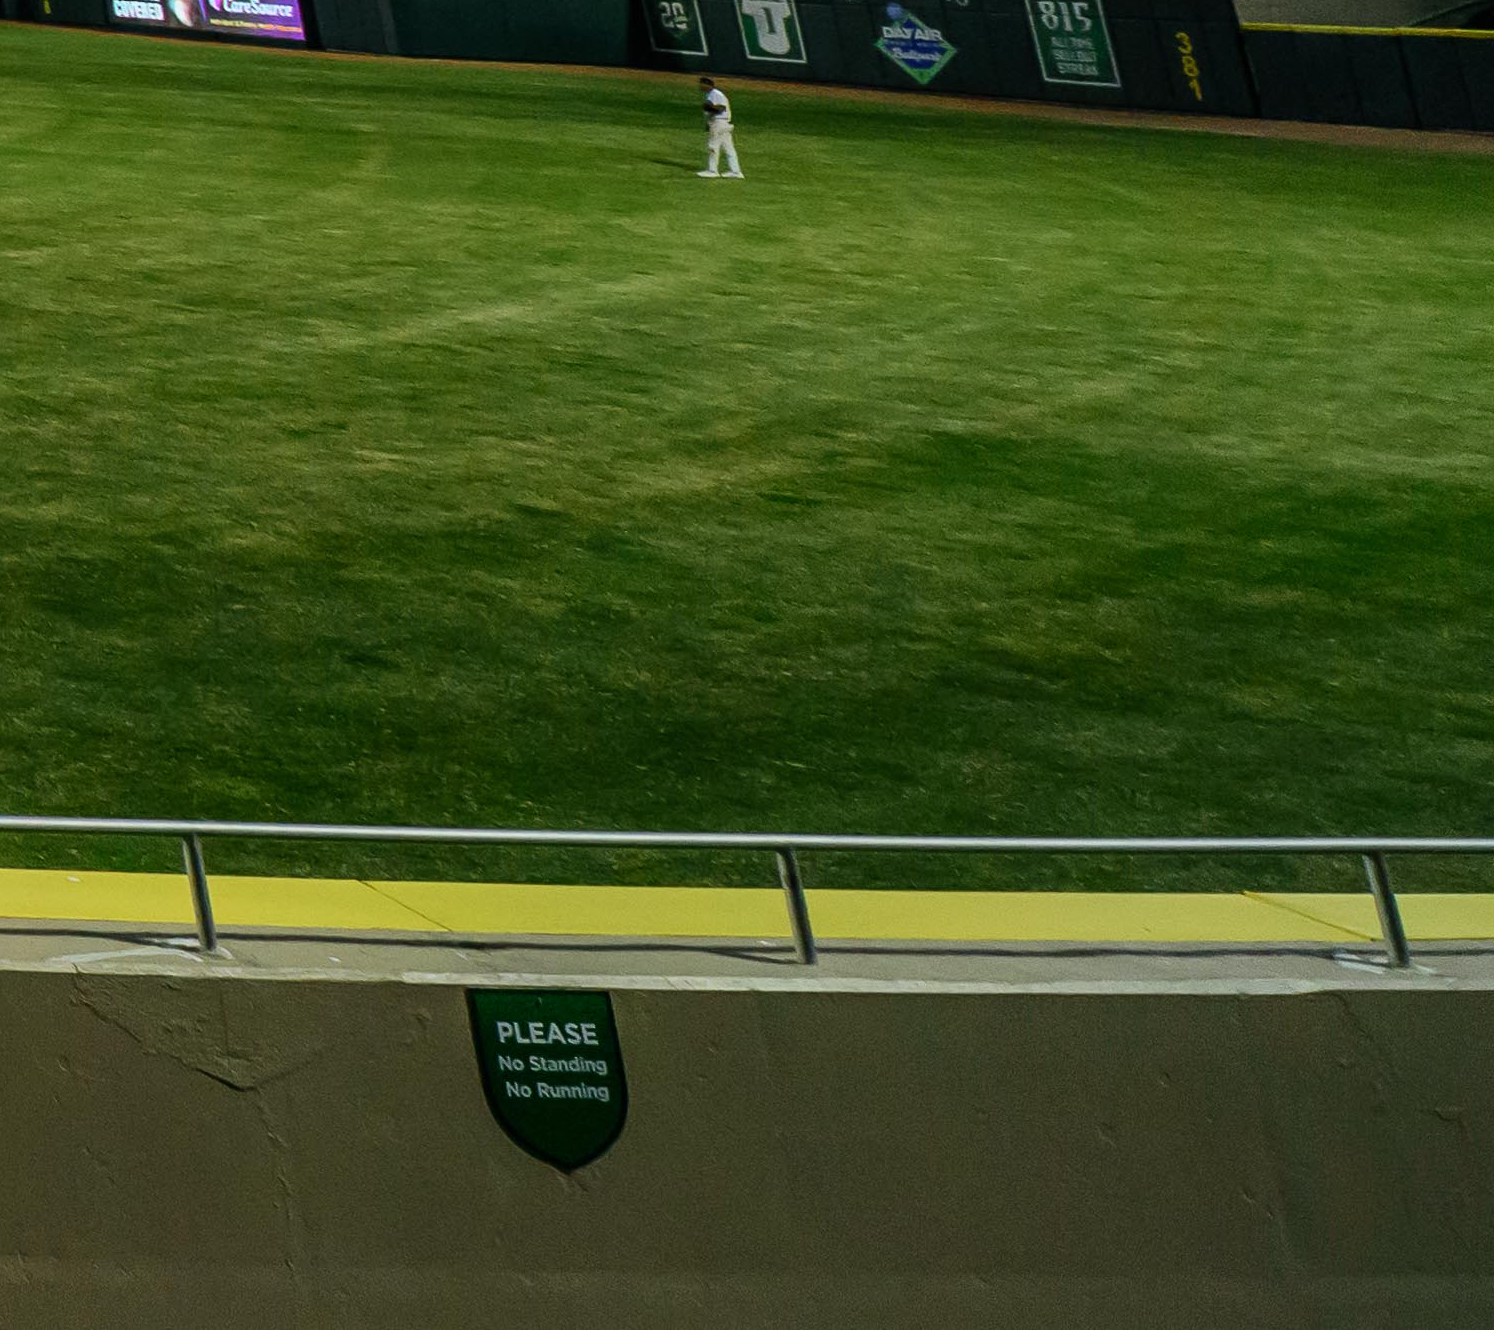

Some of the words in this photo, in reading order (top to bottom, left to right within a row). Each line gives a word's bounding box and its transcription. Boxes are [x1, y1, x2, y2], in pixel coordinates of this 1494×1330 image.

[761, 6, 777, 34] 1
[1036, 0, 1093, 32] 815
[882, 25, 912, 39] DAY
[914, 27, 943, 41] AIR
[1174, 31, 1203, 101] 381
[496, 1021, 599, 1045] PLEASE
[497, 1055, 525, 1071] No
[529, 1055, 608, 1076] Standing
[505, 1081, 532, 1098] No
[536, 1082, 610, 1102] Running
